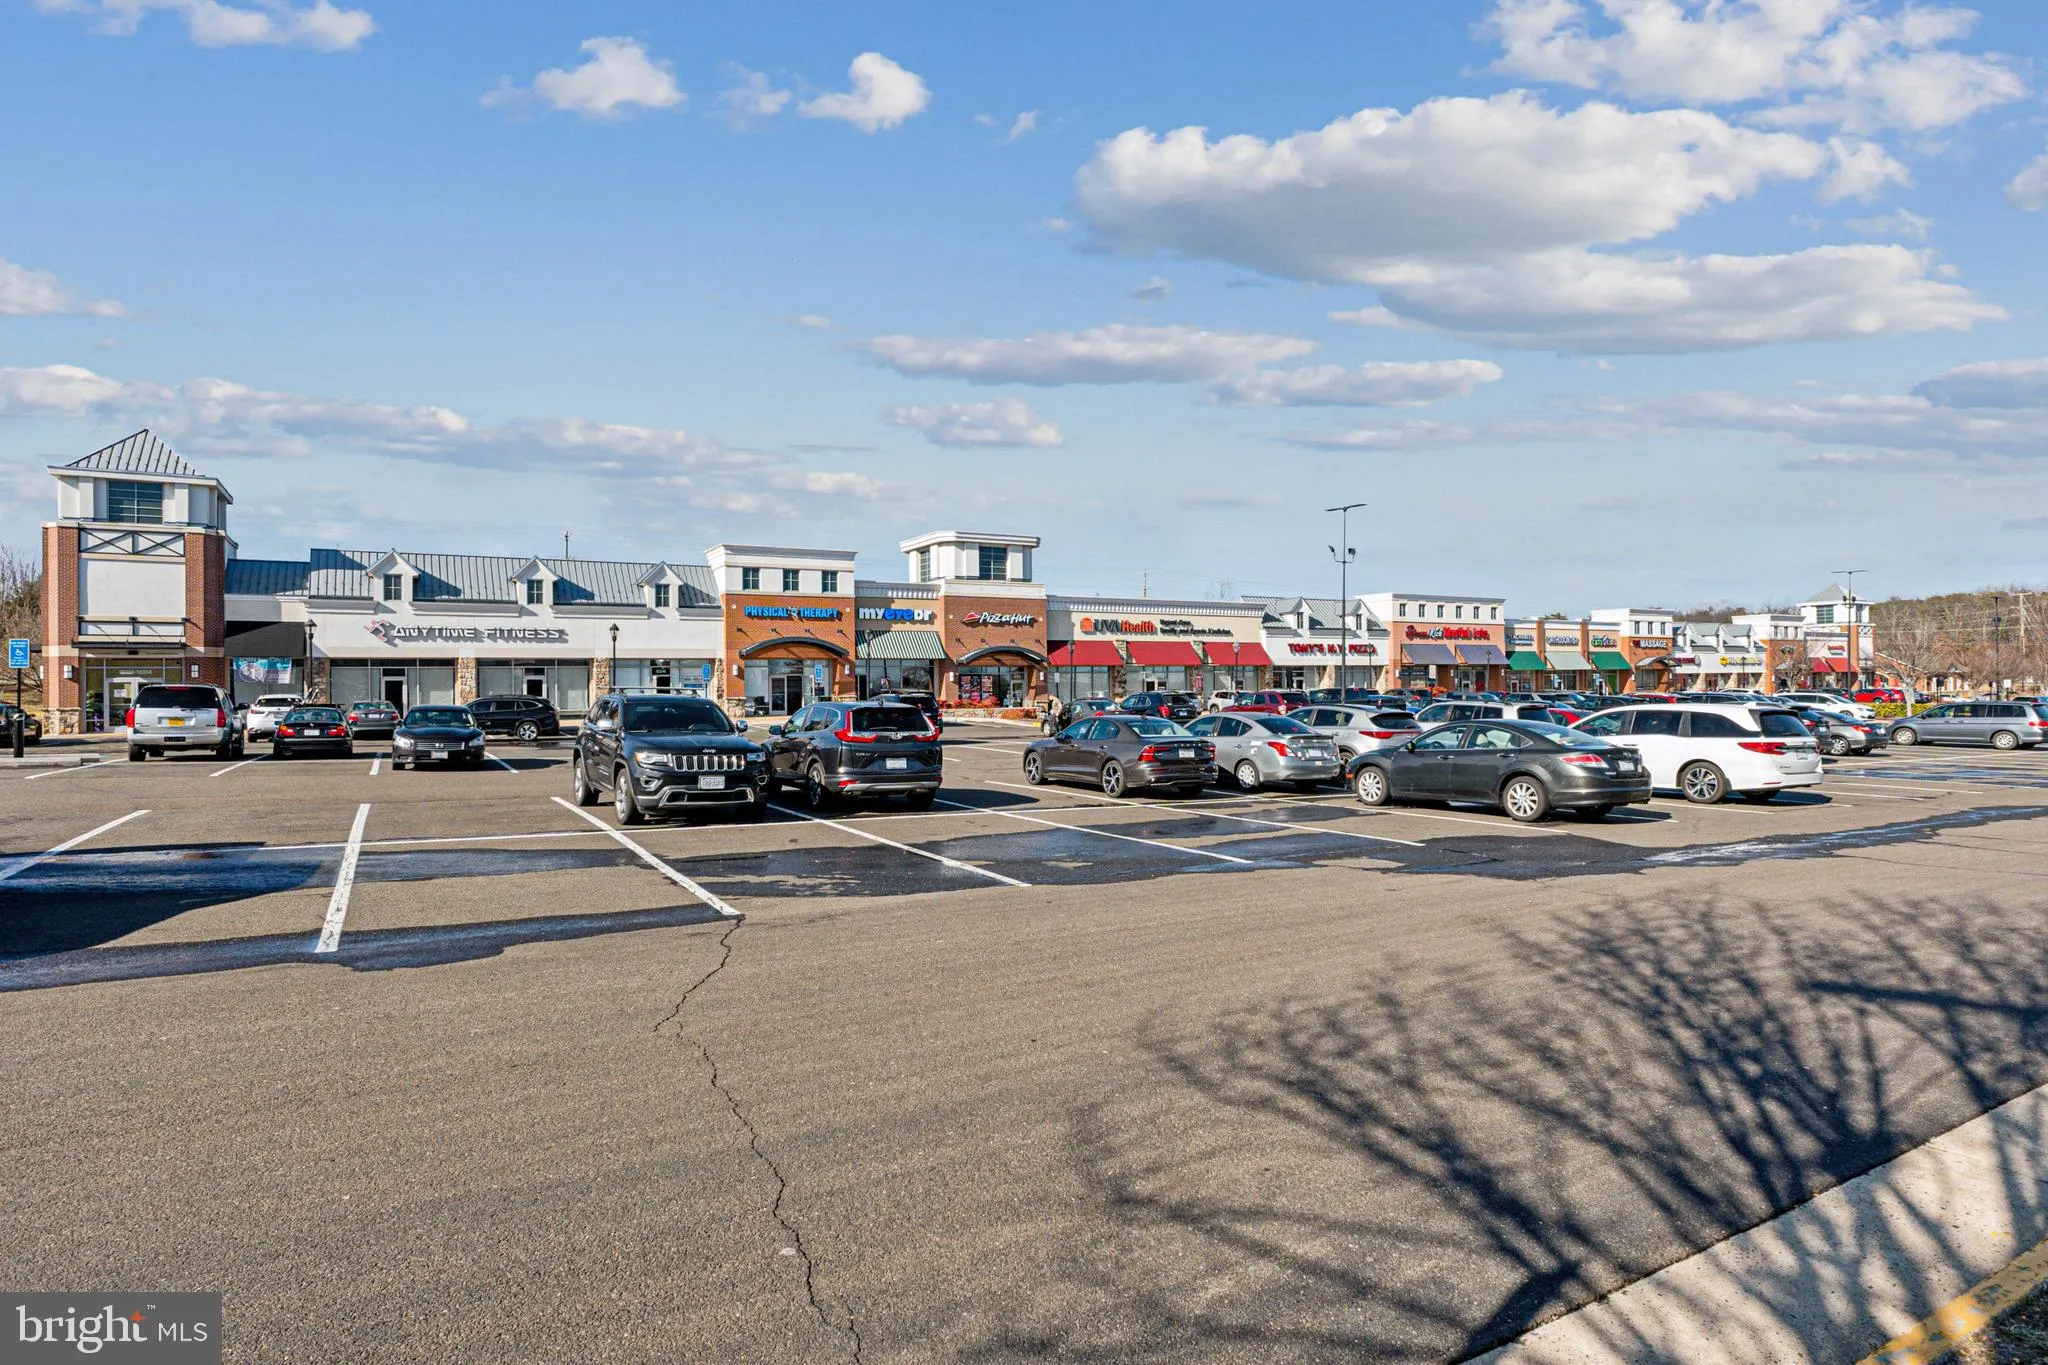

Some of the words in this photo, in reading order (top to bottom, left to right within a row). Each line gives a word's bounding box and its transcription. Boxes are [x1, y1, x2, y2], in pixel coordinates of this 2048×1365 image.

[744, 605, 789, 617] PHYSICAL
[800, 606, 839, 618] THERAPY
[1094, 619, 1120, 632] UVA
[1121, 619, 1155, 632] Health
[393, 626, 475, 638] ANYTIME
[483, 627, 560, 639] FITNESS
[1288, 643, 1325, 653] TONY'S
[1641, 639, 1667, 648] MASSAGE
